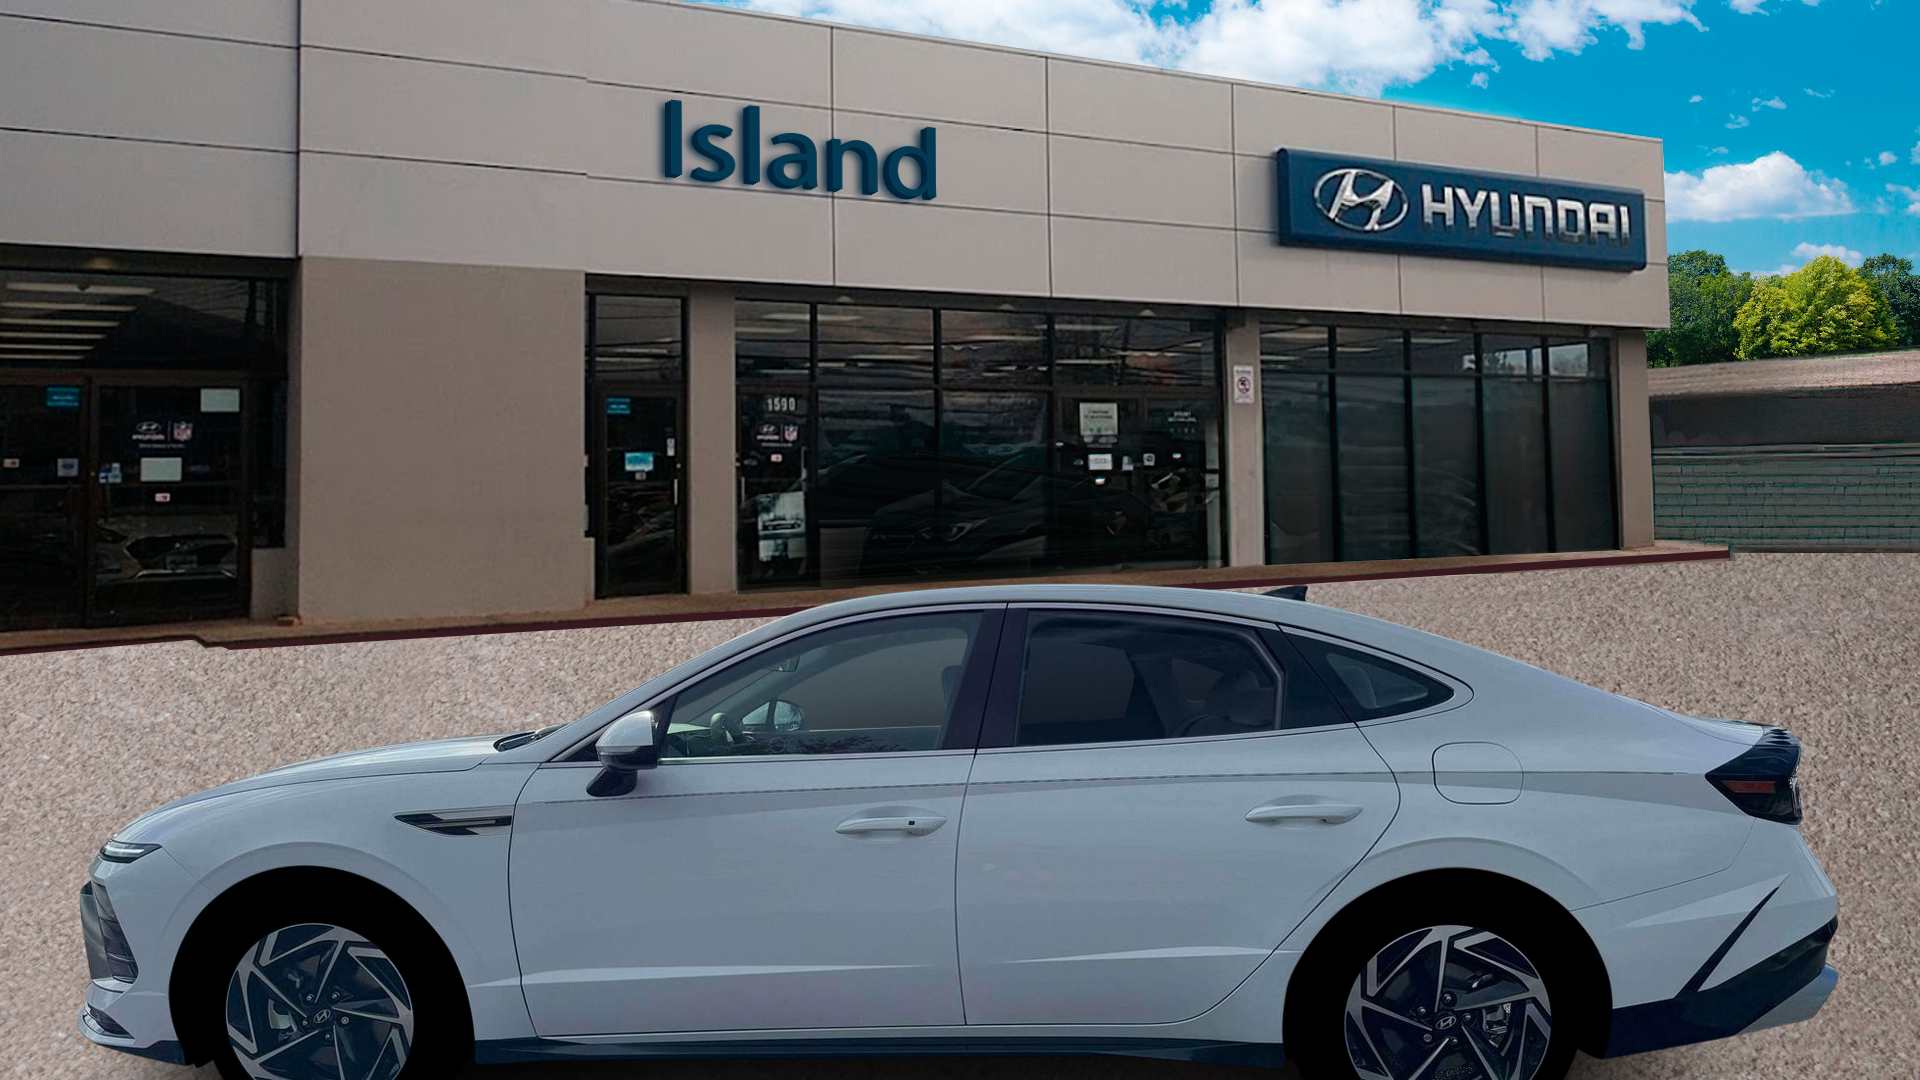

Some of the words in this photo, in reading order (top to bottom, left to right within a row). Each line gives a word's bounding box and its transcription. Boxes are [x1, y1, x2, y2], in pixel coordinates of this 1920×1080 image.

[664, 99, 937, 201] Island
[1421, 184, 1631, 245] HYUNDAI
[767, 396, 796, 412] 1590
